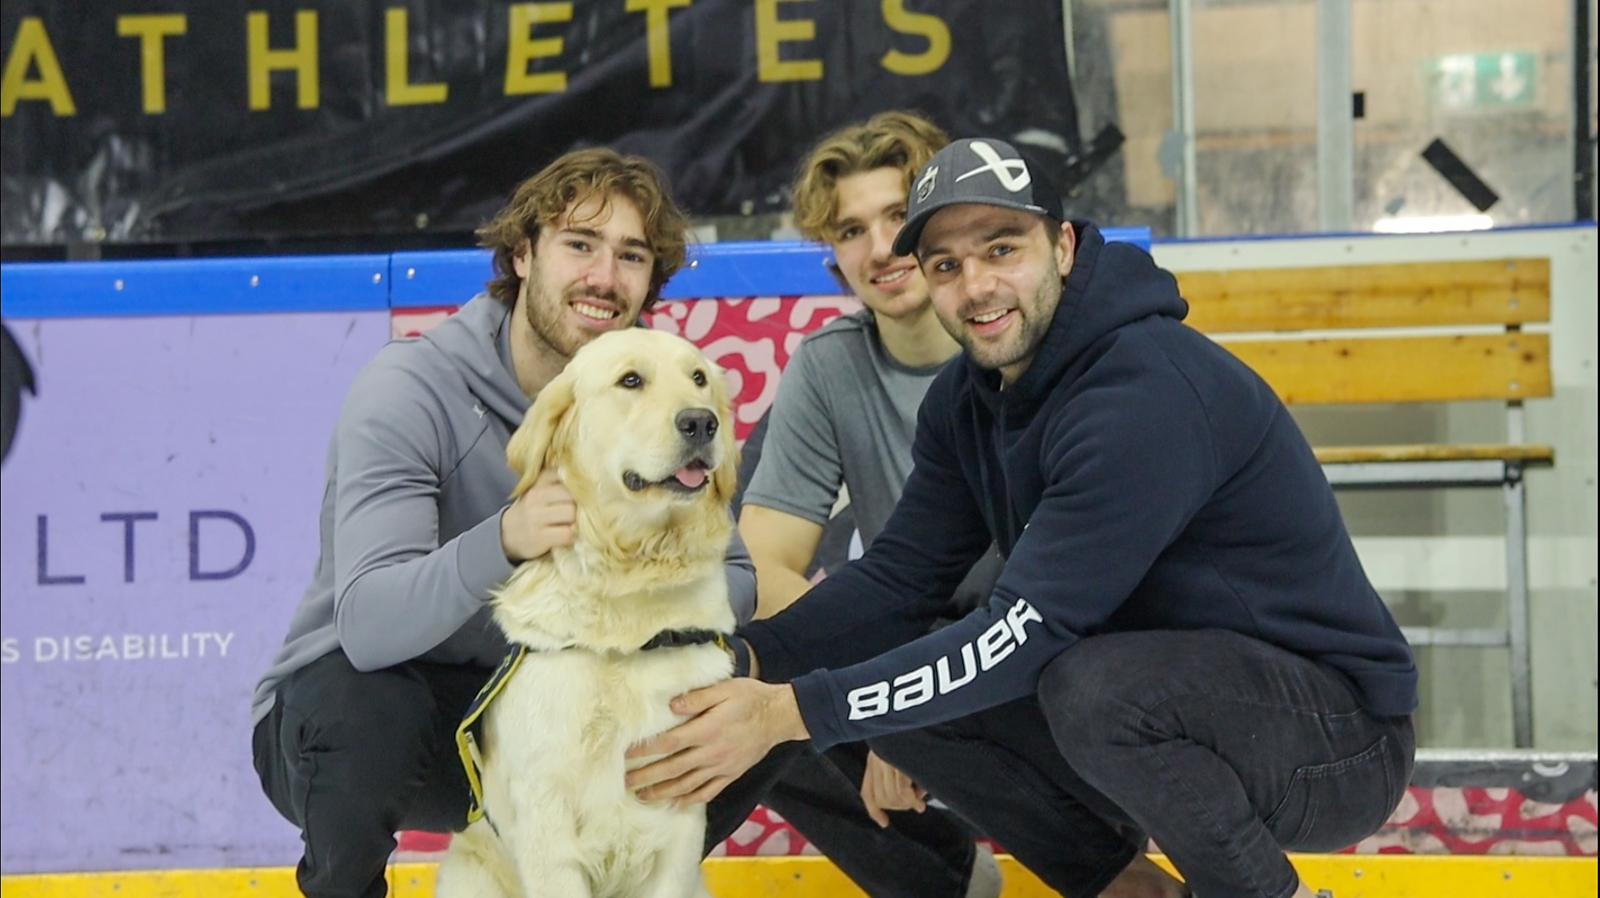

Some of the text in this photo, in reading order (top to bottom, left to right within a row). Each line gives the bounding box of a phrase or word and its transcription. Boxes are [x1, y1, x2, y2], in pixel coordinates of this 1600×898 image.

[1, 0, 952, 116] ATHLETES
[36, 509, 256, 585] LTD
[35, 632, 234, 662] DISABILITY
